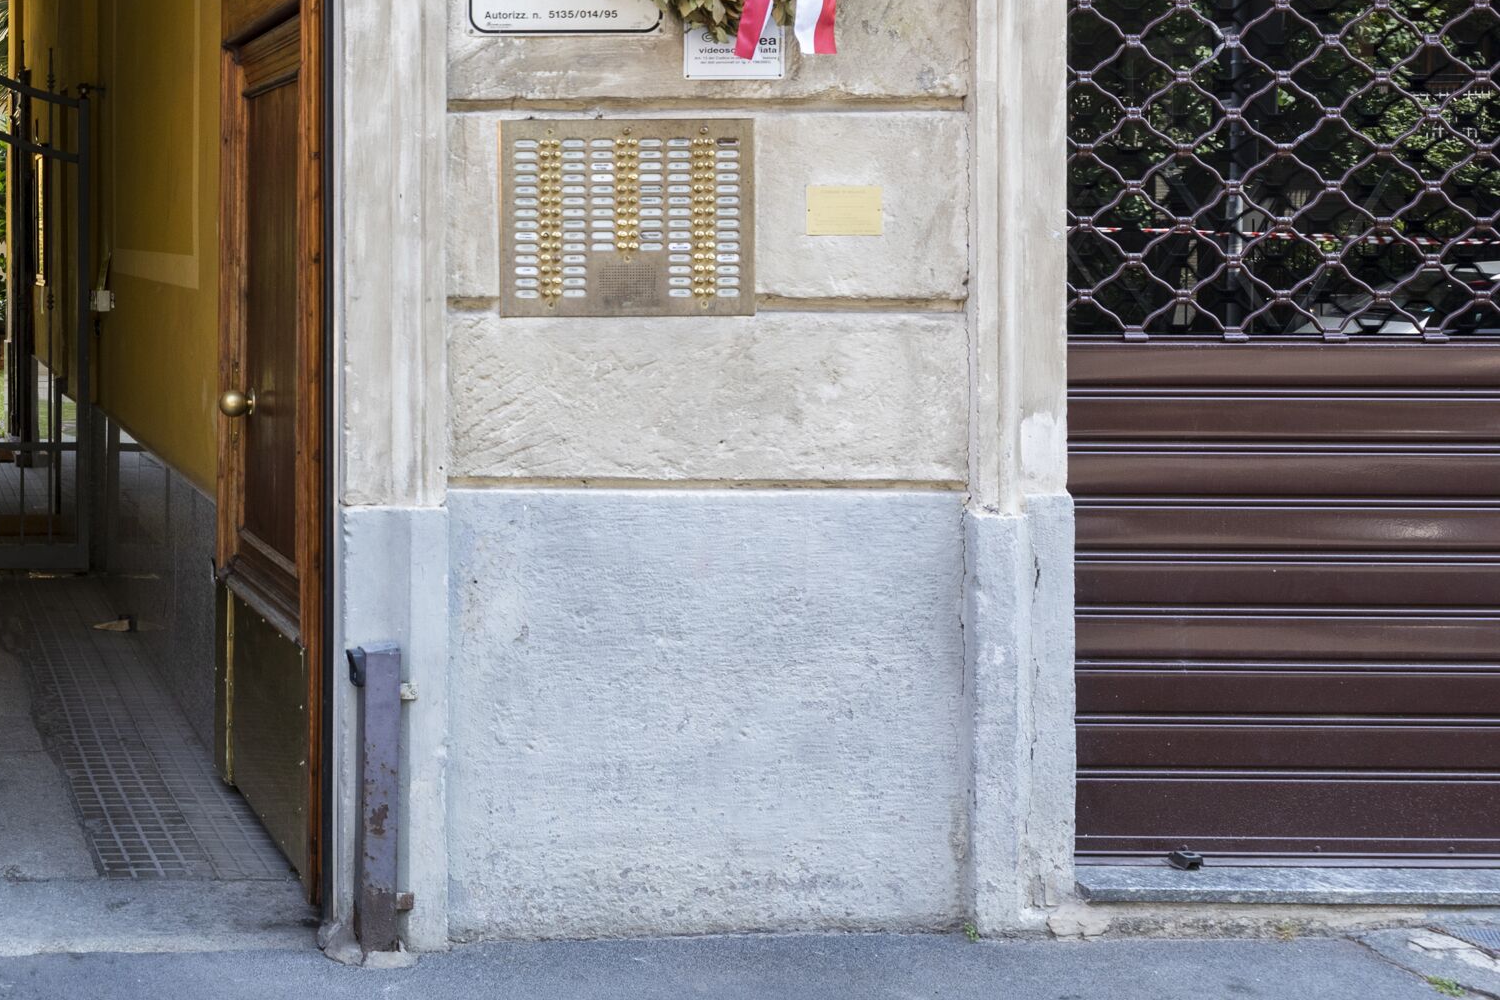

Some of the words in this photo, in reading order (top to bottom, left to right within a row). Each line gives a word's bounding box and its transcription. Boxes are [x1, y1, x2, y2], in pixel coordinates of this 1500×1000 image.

[484, 10, 529, 21] Autorizz.
[532, 12, 542, 20] n.
[548, 9, 619, 20] 5135/014/95
